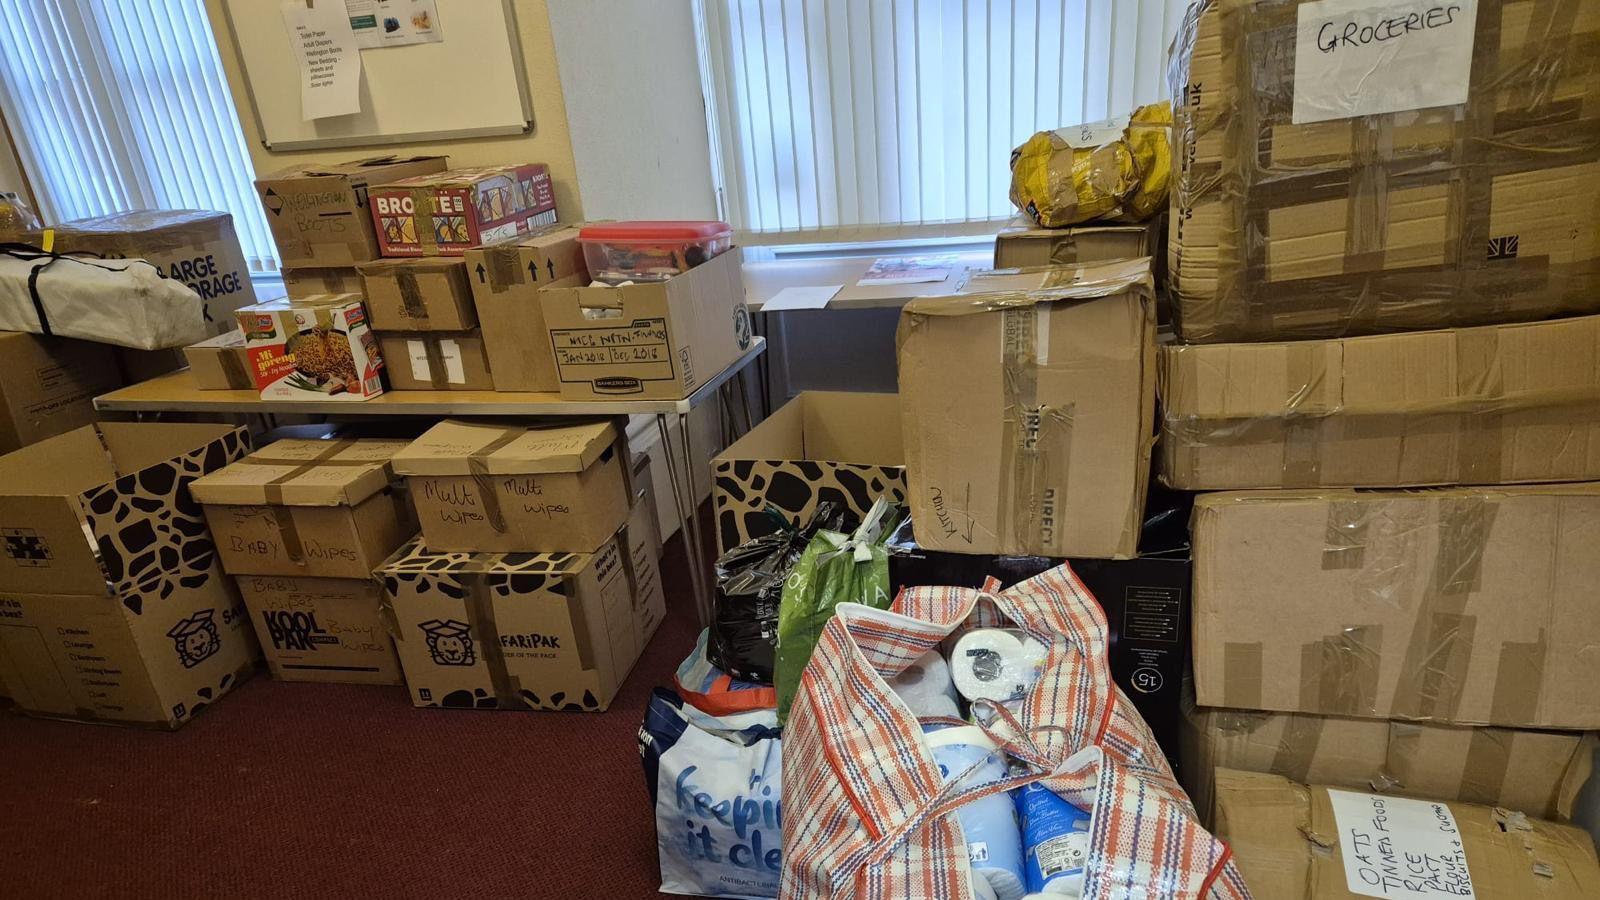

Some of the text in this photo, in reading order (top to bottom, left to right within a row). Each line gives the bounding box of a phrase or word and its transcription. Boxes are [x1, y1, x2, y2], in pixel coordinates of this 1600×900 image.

[1317, 6, 1460, 53] GROCERIES
[376, 190, 453, 214] BROTË
[187, 271, 242, 300] ORAGE
[258, 353, 296, 371] goreng
[562, 352, 584, 363] JAN
[585, 352, 606, 362] 2018
[633, 347, 658, 360] 2018
[230, 535, 279, 560] BABY
[262, 610, 327, 635] KOOL
[271, 631, 319, 652] PAK
[1138, 673, 1157, 687] 15
[686, 819, 723, 865] it
[1351, 828, 1381, 886] OATS
[1403, 851, 1429, 894] RICE
